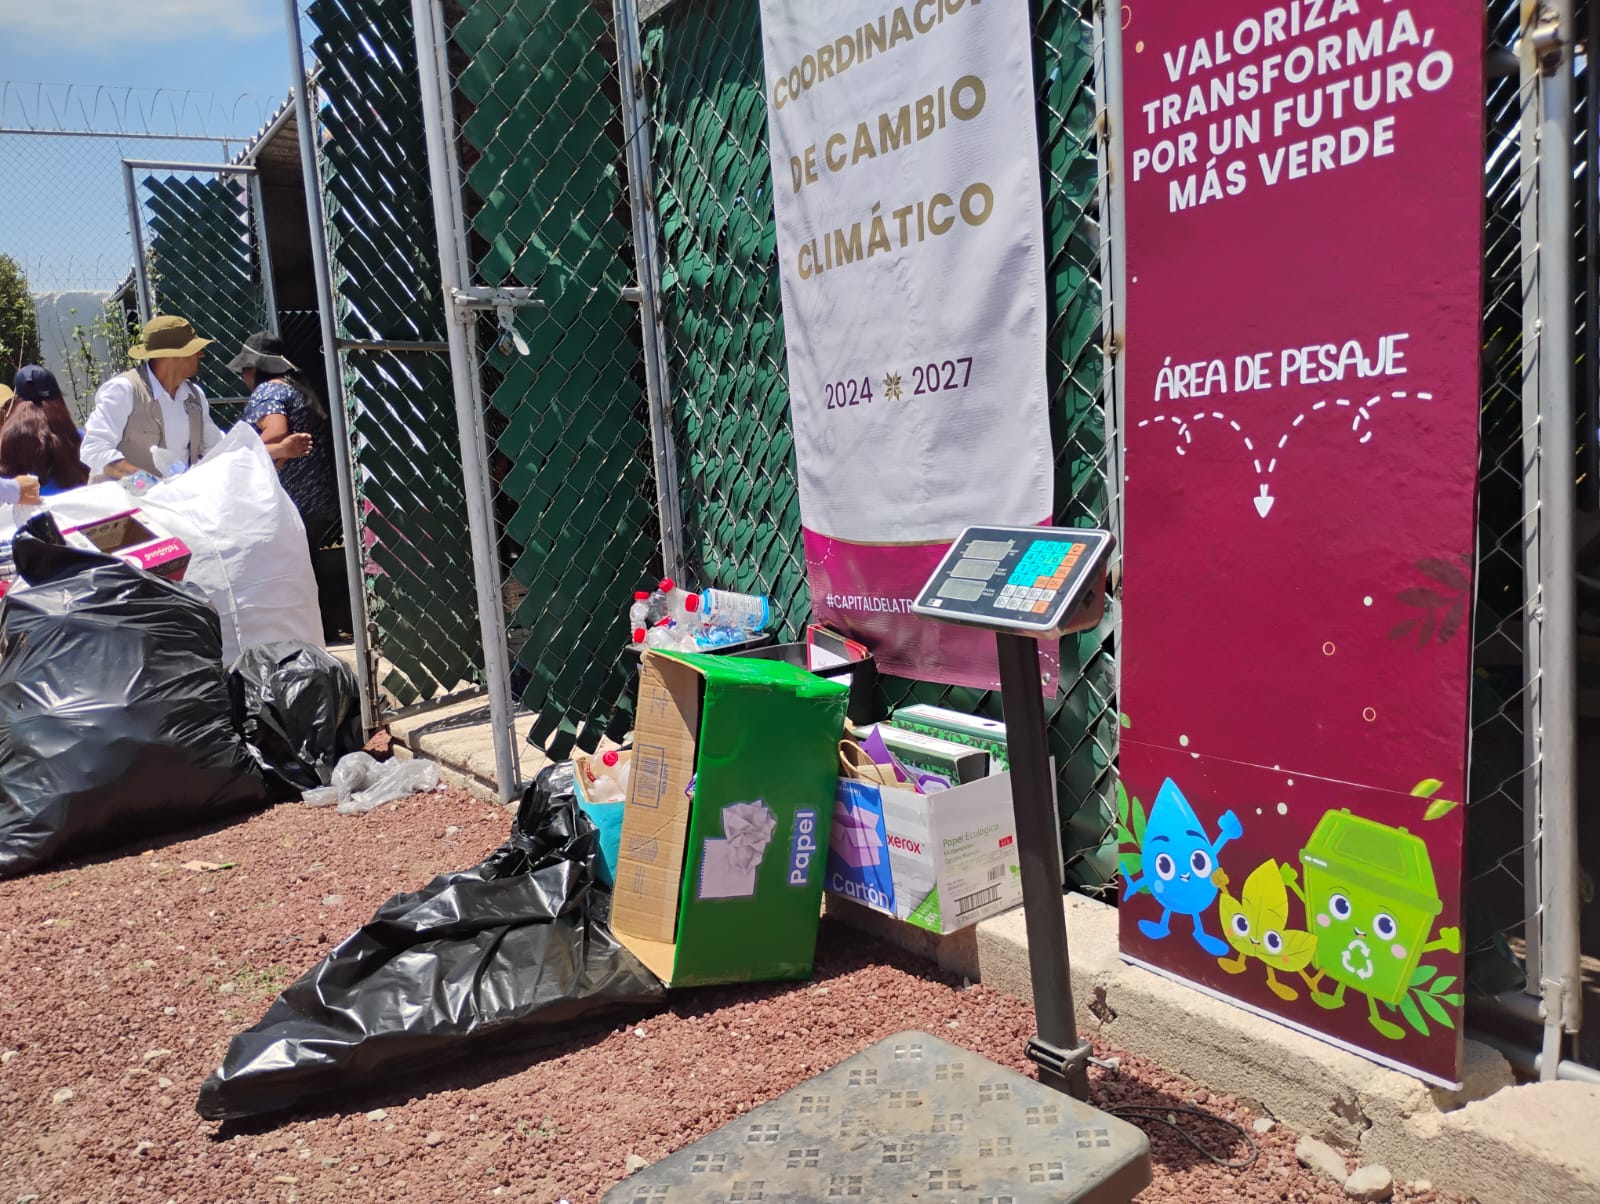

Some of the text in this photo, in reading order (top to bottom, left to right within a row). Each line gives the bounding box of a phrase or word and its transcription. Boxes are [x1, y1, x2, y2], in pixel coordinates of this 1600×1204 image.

[773, 0, 982, 110] COORDINACI
[1142, 9, 1435, 135] TRANSFORMA,
[790, 74, 986, 194] DE CAMBIO
[1133, 50, 1454, 182] POR UN FUTURO
[1169, 116, 1396, 213] MÁS VERDE
[797, 182, 994, 281] CLIMÁTICO
[825, 356, 974, 410] 2024 2027
[1154, 333, 1410, 402] ÁREA DE PESAJE
[790, 812, 816, 884] Papel
[832, 872, 890, 909] Cartón
[887, 833, 921, 855] xerox
